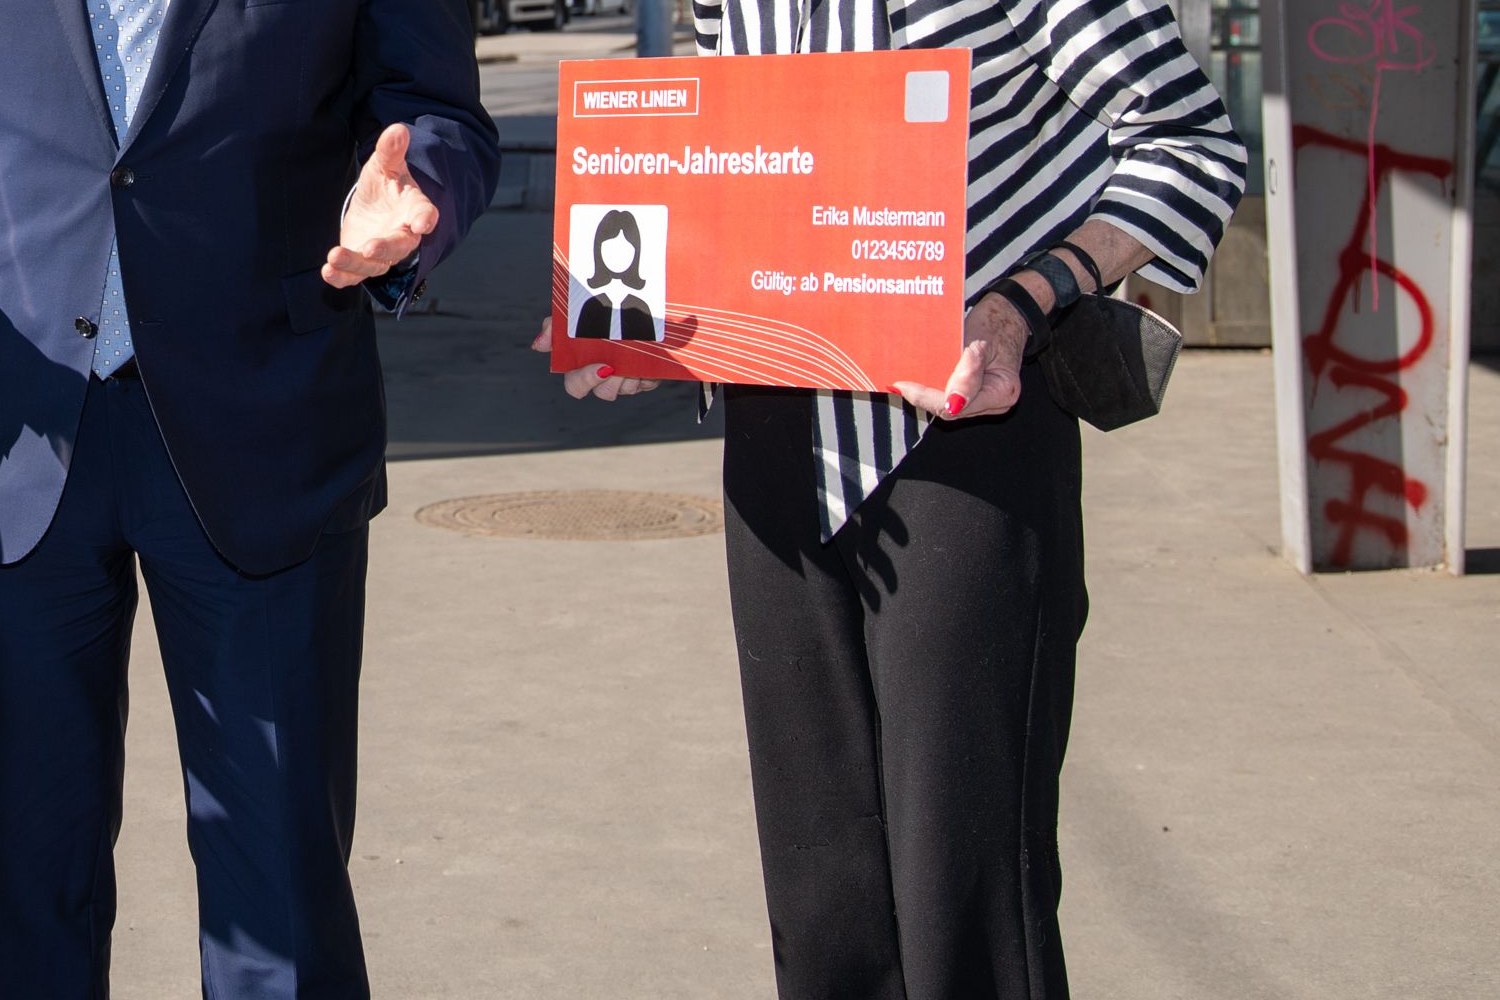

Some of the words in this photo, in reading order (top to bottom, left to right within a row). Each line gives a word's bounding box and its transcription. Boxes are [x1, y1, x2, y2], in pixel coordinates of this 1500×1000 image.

[583, 90, 638, 109] WIENER
[641, 89, 688, 108] LINIEN
[572, 145, 814, 175] Senioren-Jahreskarte
[812, 207, 849, 226] Erika
[852, 206, 945, 227] Mustermann
[851, 240, 945, 261] 0123456789
[751, 270, 797, 296] Gültig:
[800, 274, 819, 293] ab
[823, 273, 944, 296] Pensionsantritt
